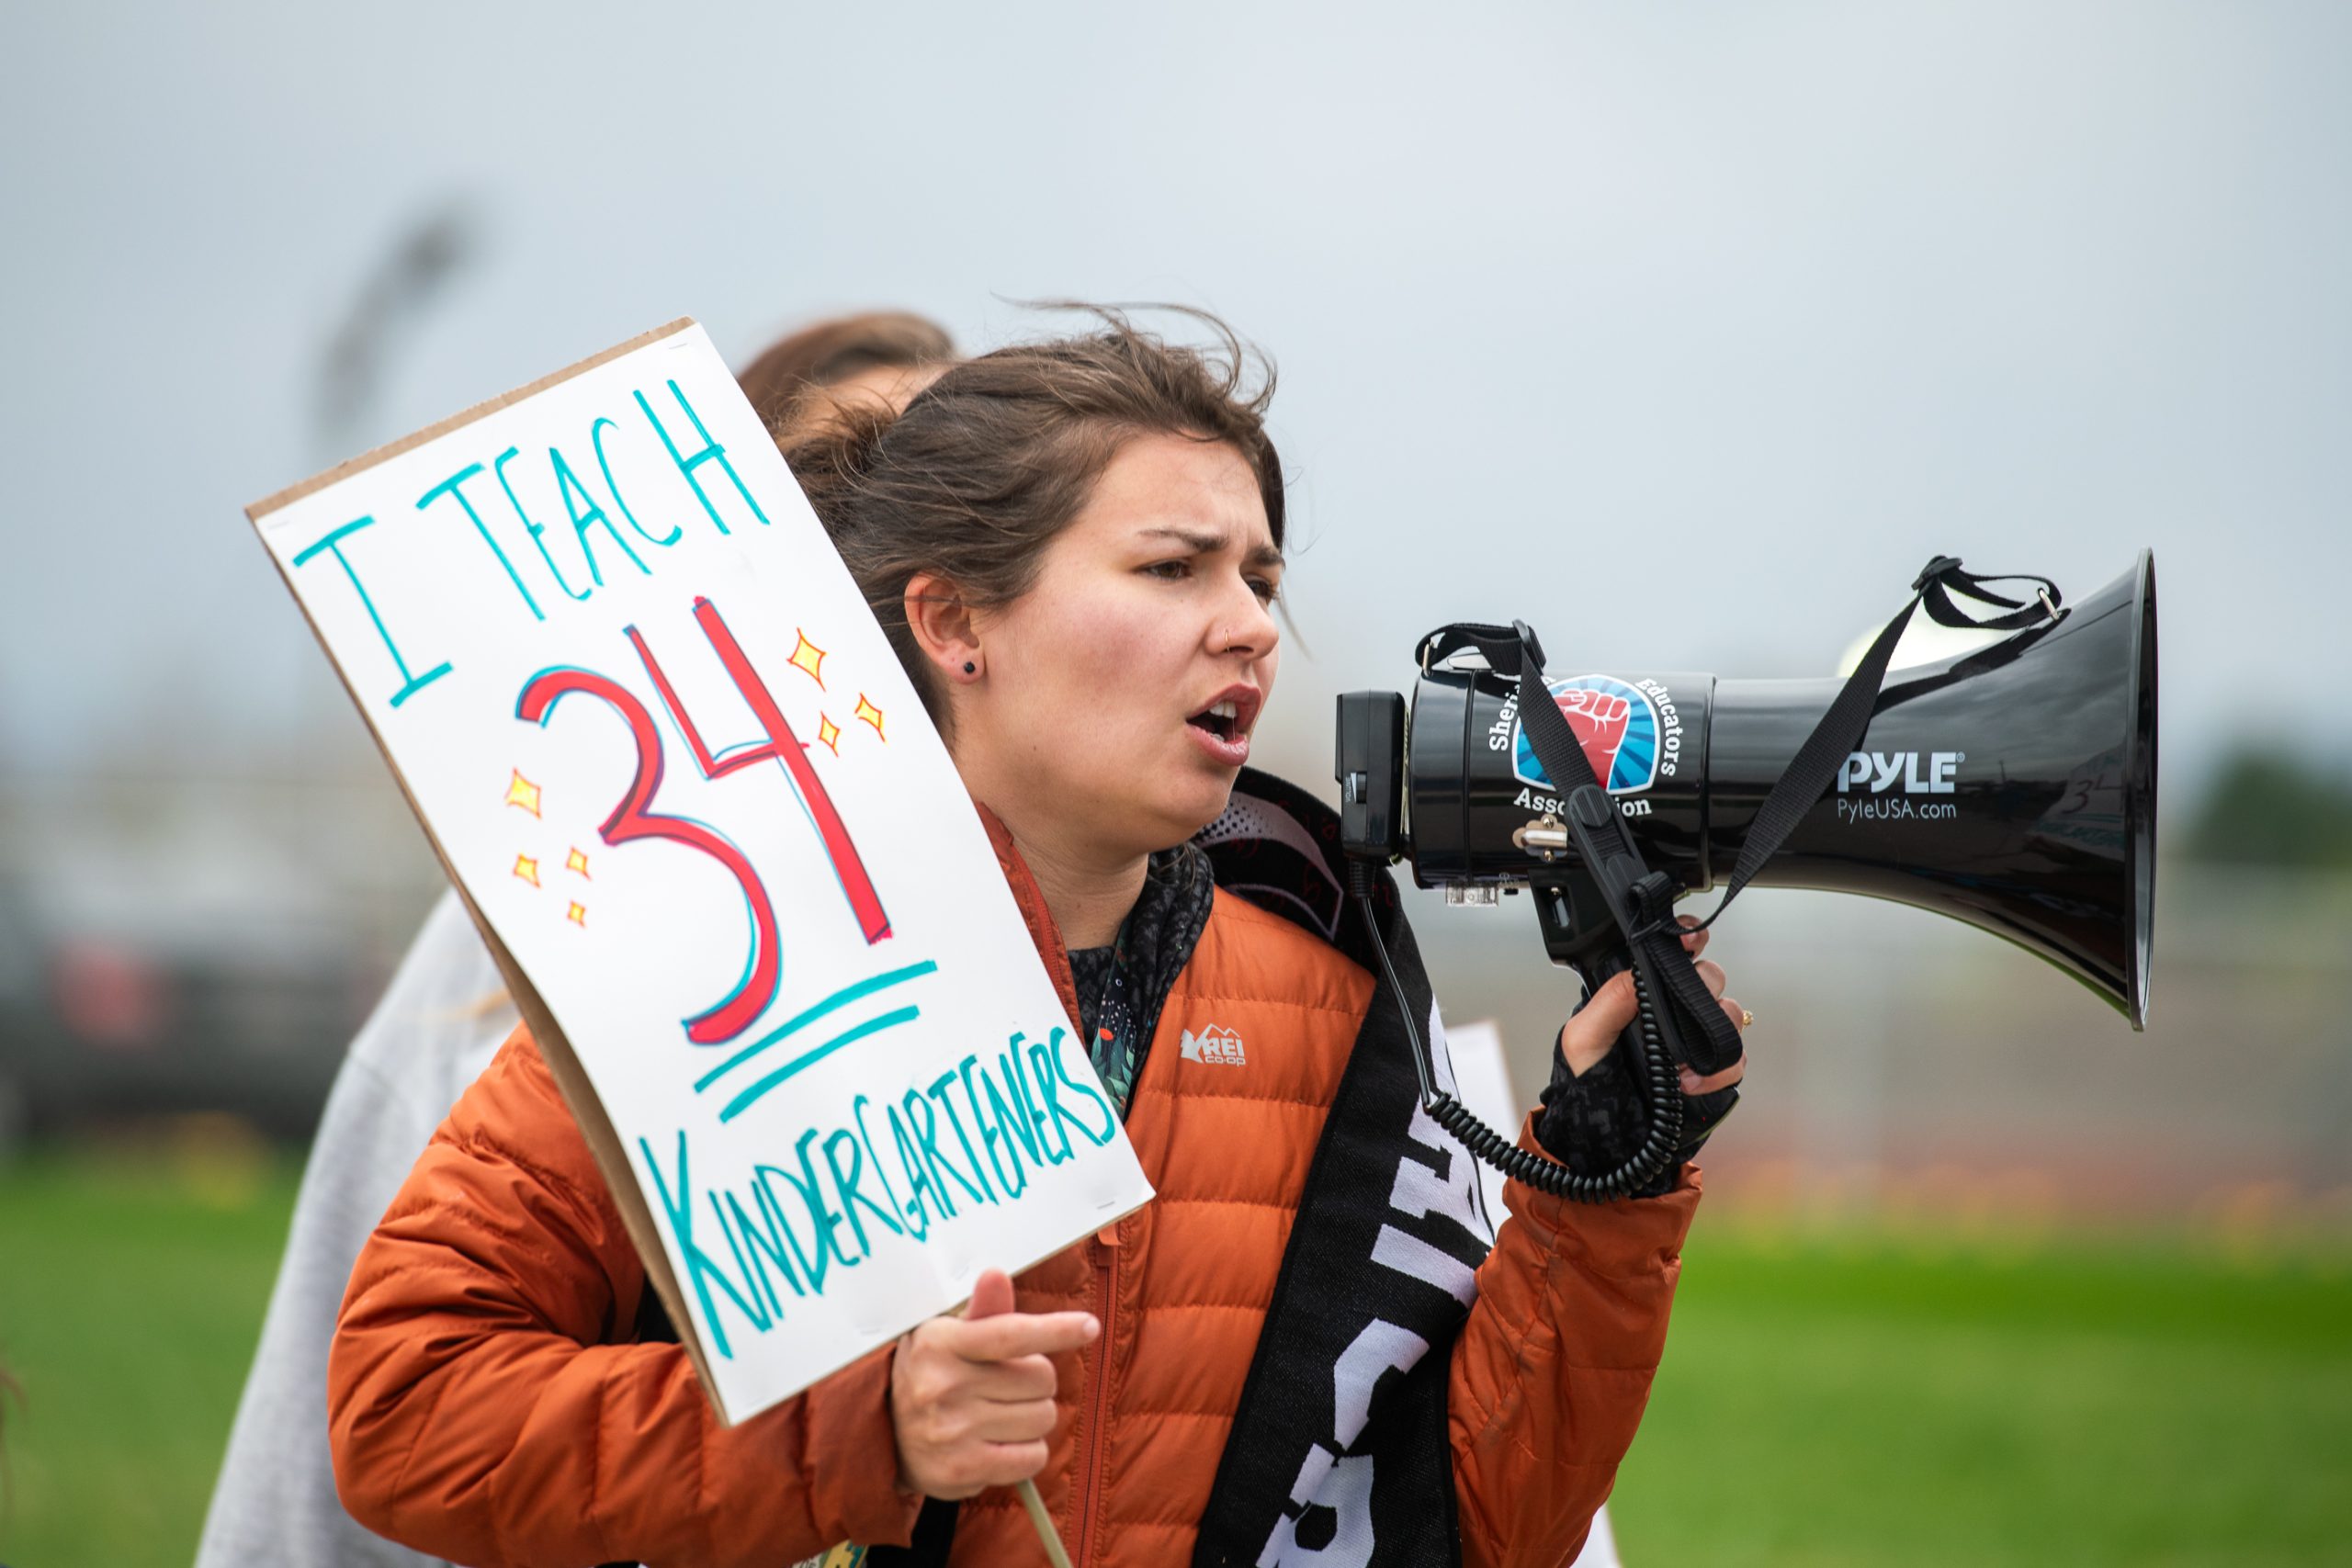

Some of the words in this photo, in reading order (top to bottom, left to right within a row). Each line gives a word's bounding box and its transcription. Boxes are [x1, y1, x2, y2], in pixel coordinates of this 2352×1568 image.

[292, 515, 454, 708] I
[416, 379, 771, 622] TEACH
[515, 595, 894, 1045] 34
[1635, 678, 1683, 777] Educators
[1838, 797, 1958, 825] PyleUSA.com
[1202, 1037, 1245, 1057] REI
[639, 1026, 1116, 1359] KINDERGARTENERS
